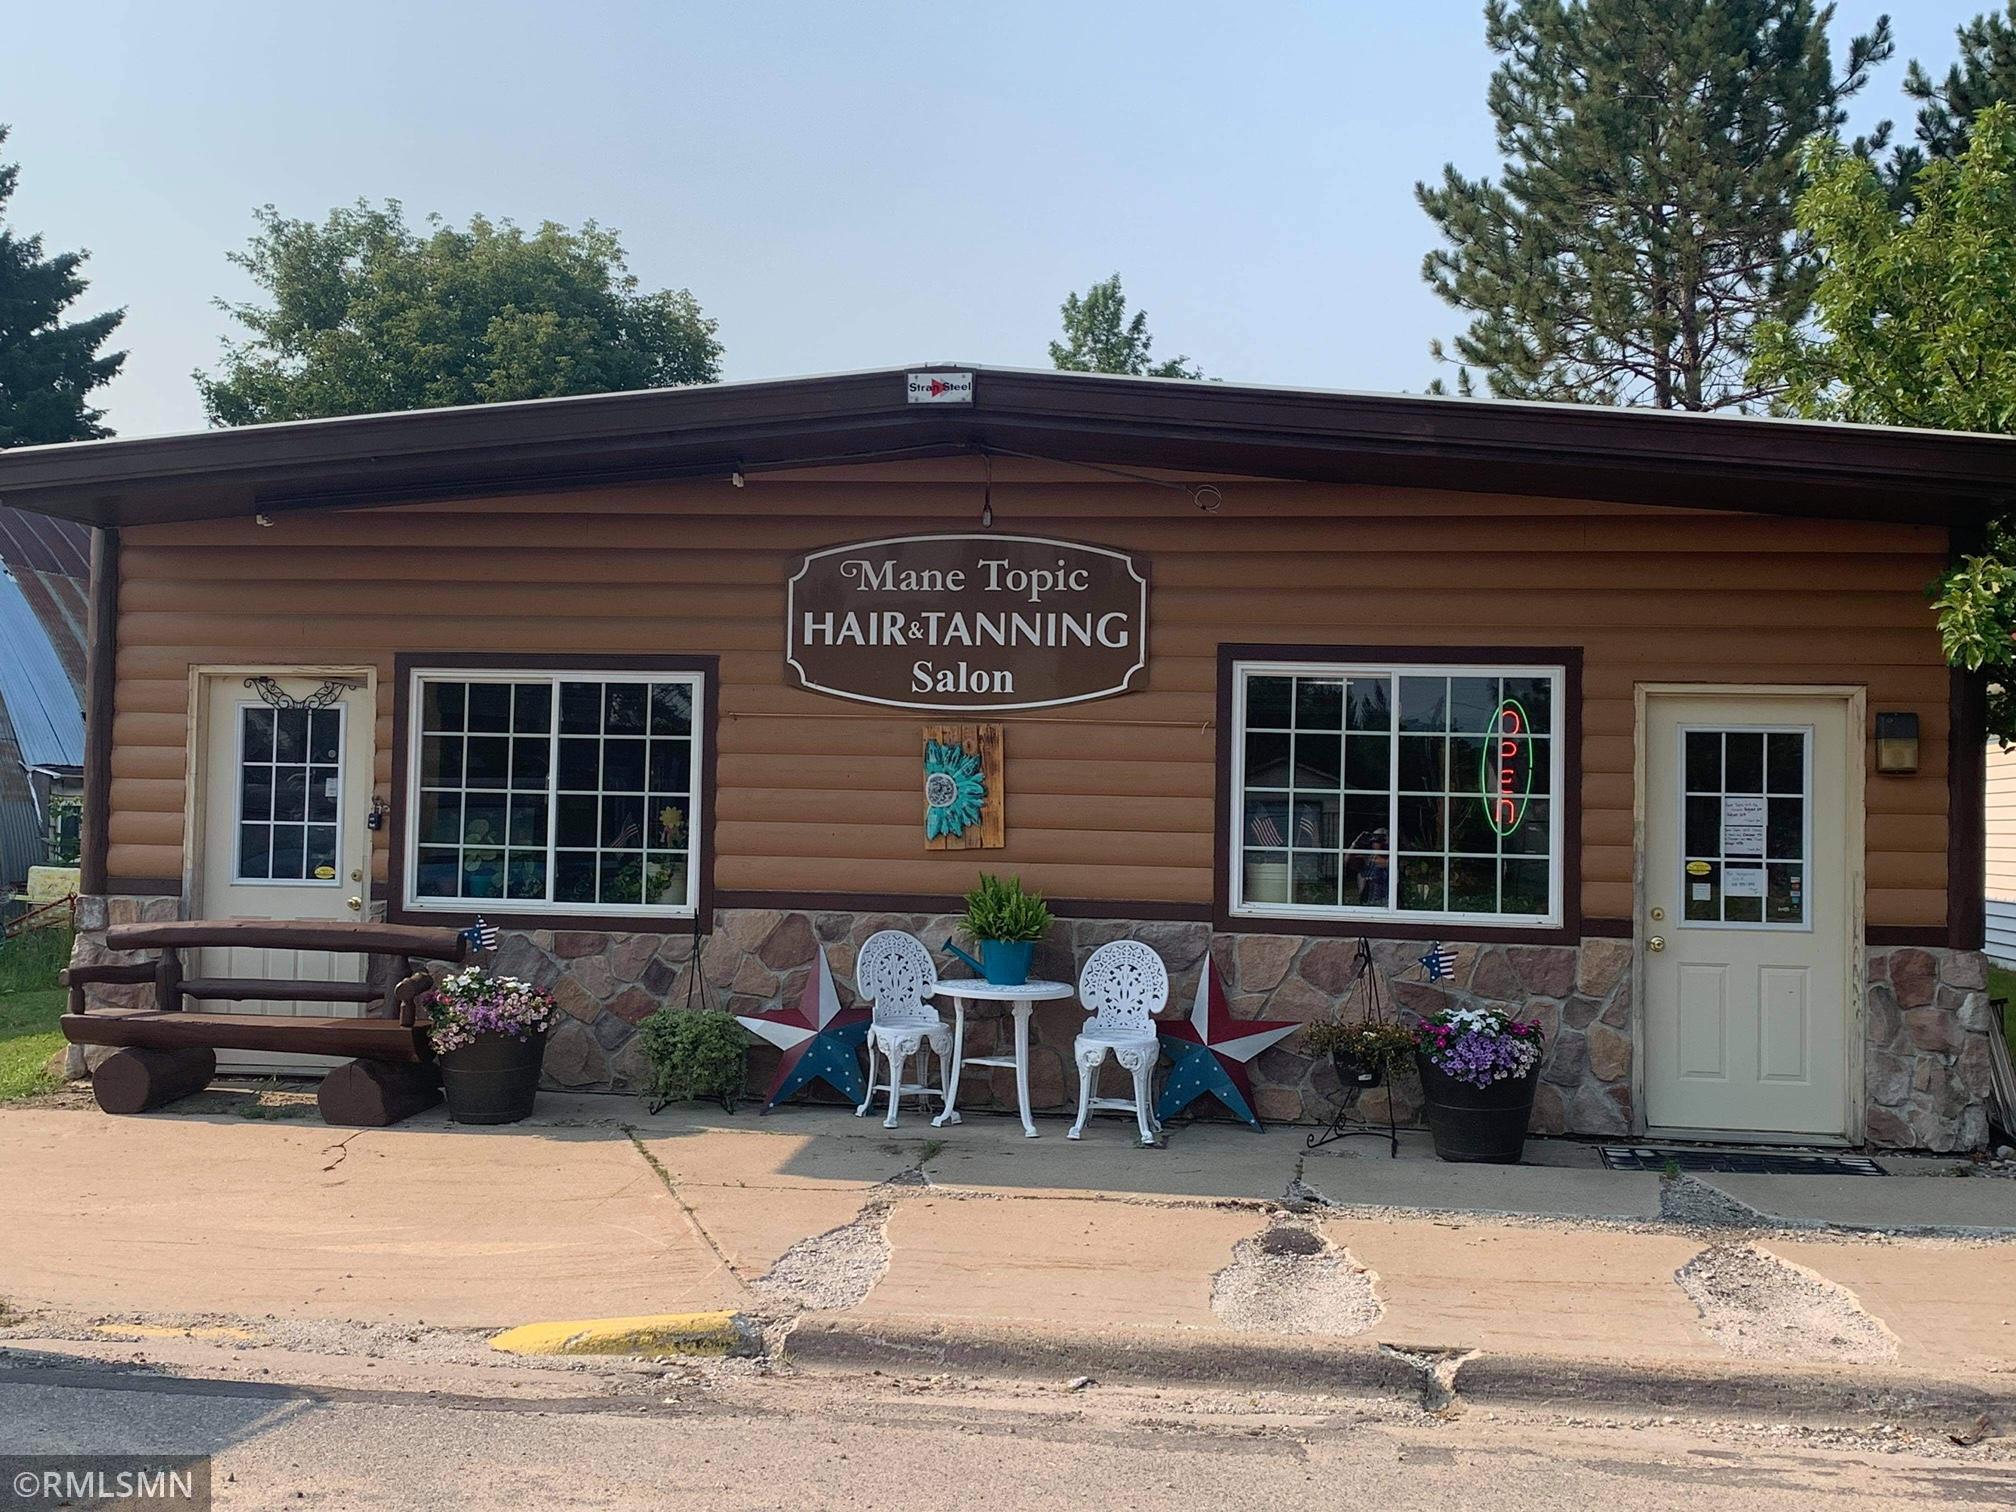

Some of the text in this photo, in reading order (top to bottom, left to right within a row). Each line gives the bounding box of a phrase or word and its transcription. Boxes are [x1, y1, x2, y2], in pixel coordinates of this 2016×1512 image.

[909, 382, 971, 392] Stran Steel
[840, 558, 1089, 603] Mane Topic
[911, 660, 1015, 694] Salon
